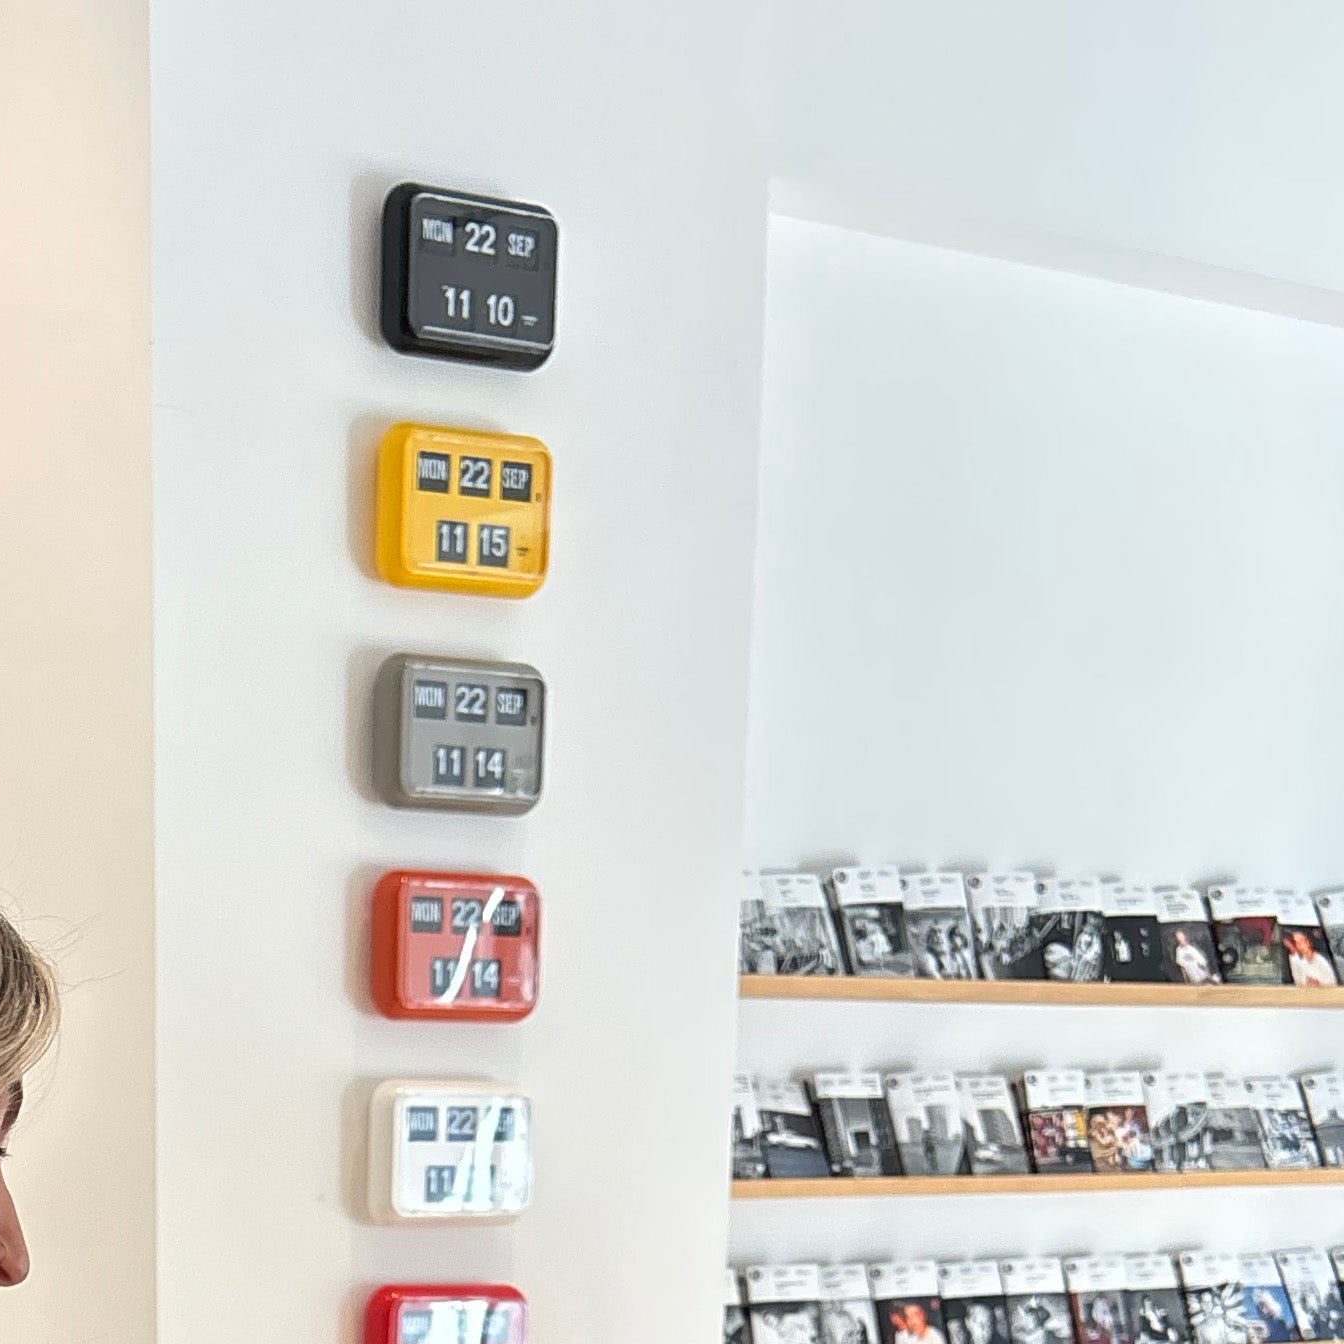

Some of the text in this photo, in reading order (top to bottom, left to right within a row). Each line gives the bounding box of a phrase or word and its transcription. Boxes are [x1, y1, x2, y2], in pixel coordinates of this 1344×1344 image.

[464, 221, 496, 255] 22
[507, 232, 535, 258] SEP
[444, 286, 514, 327] 11 10
[460, 459, 490, 490] 22
[502, 466, 528, 490] SEP
[440, 523, 505, 557] 11 15
[456, 686, 486, 715] 22
[497, 693, 524, 714] SEP
[436, 748, 504, 780] 11 14
[452, 901, 480, 927] 22
[472, 961, 499, 989] 14
[447, 1109, 476, 1134] 22
